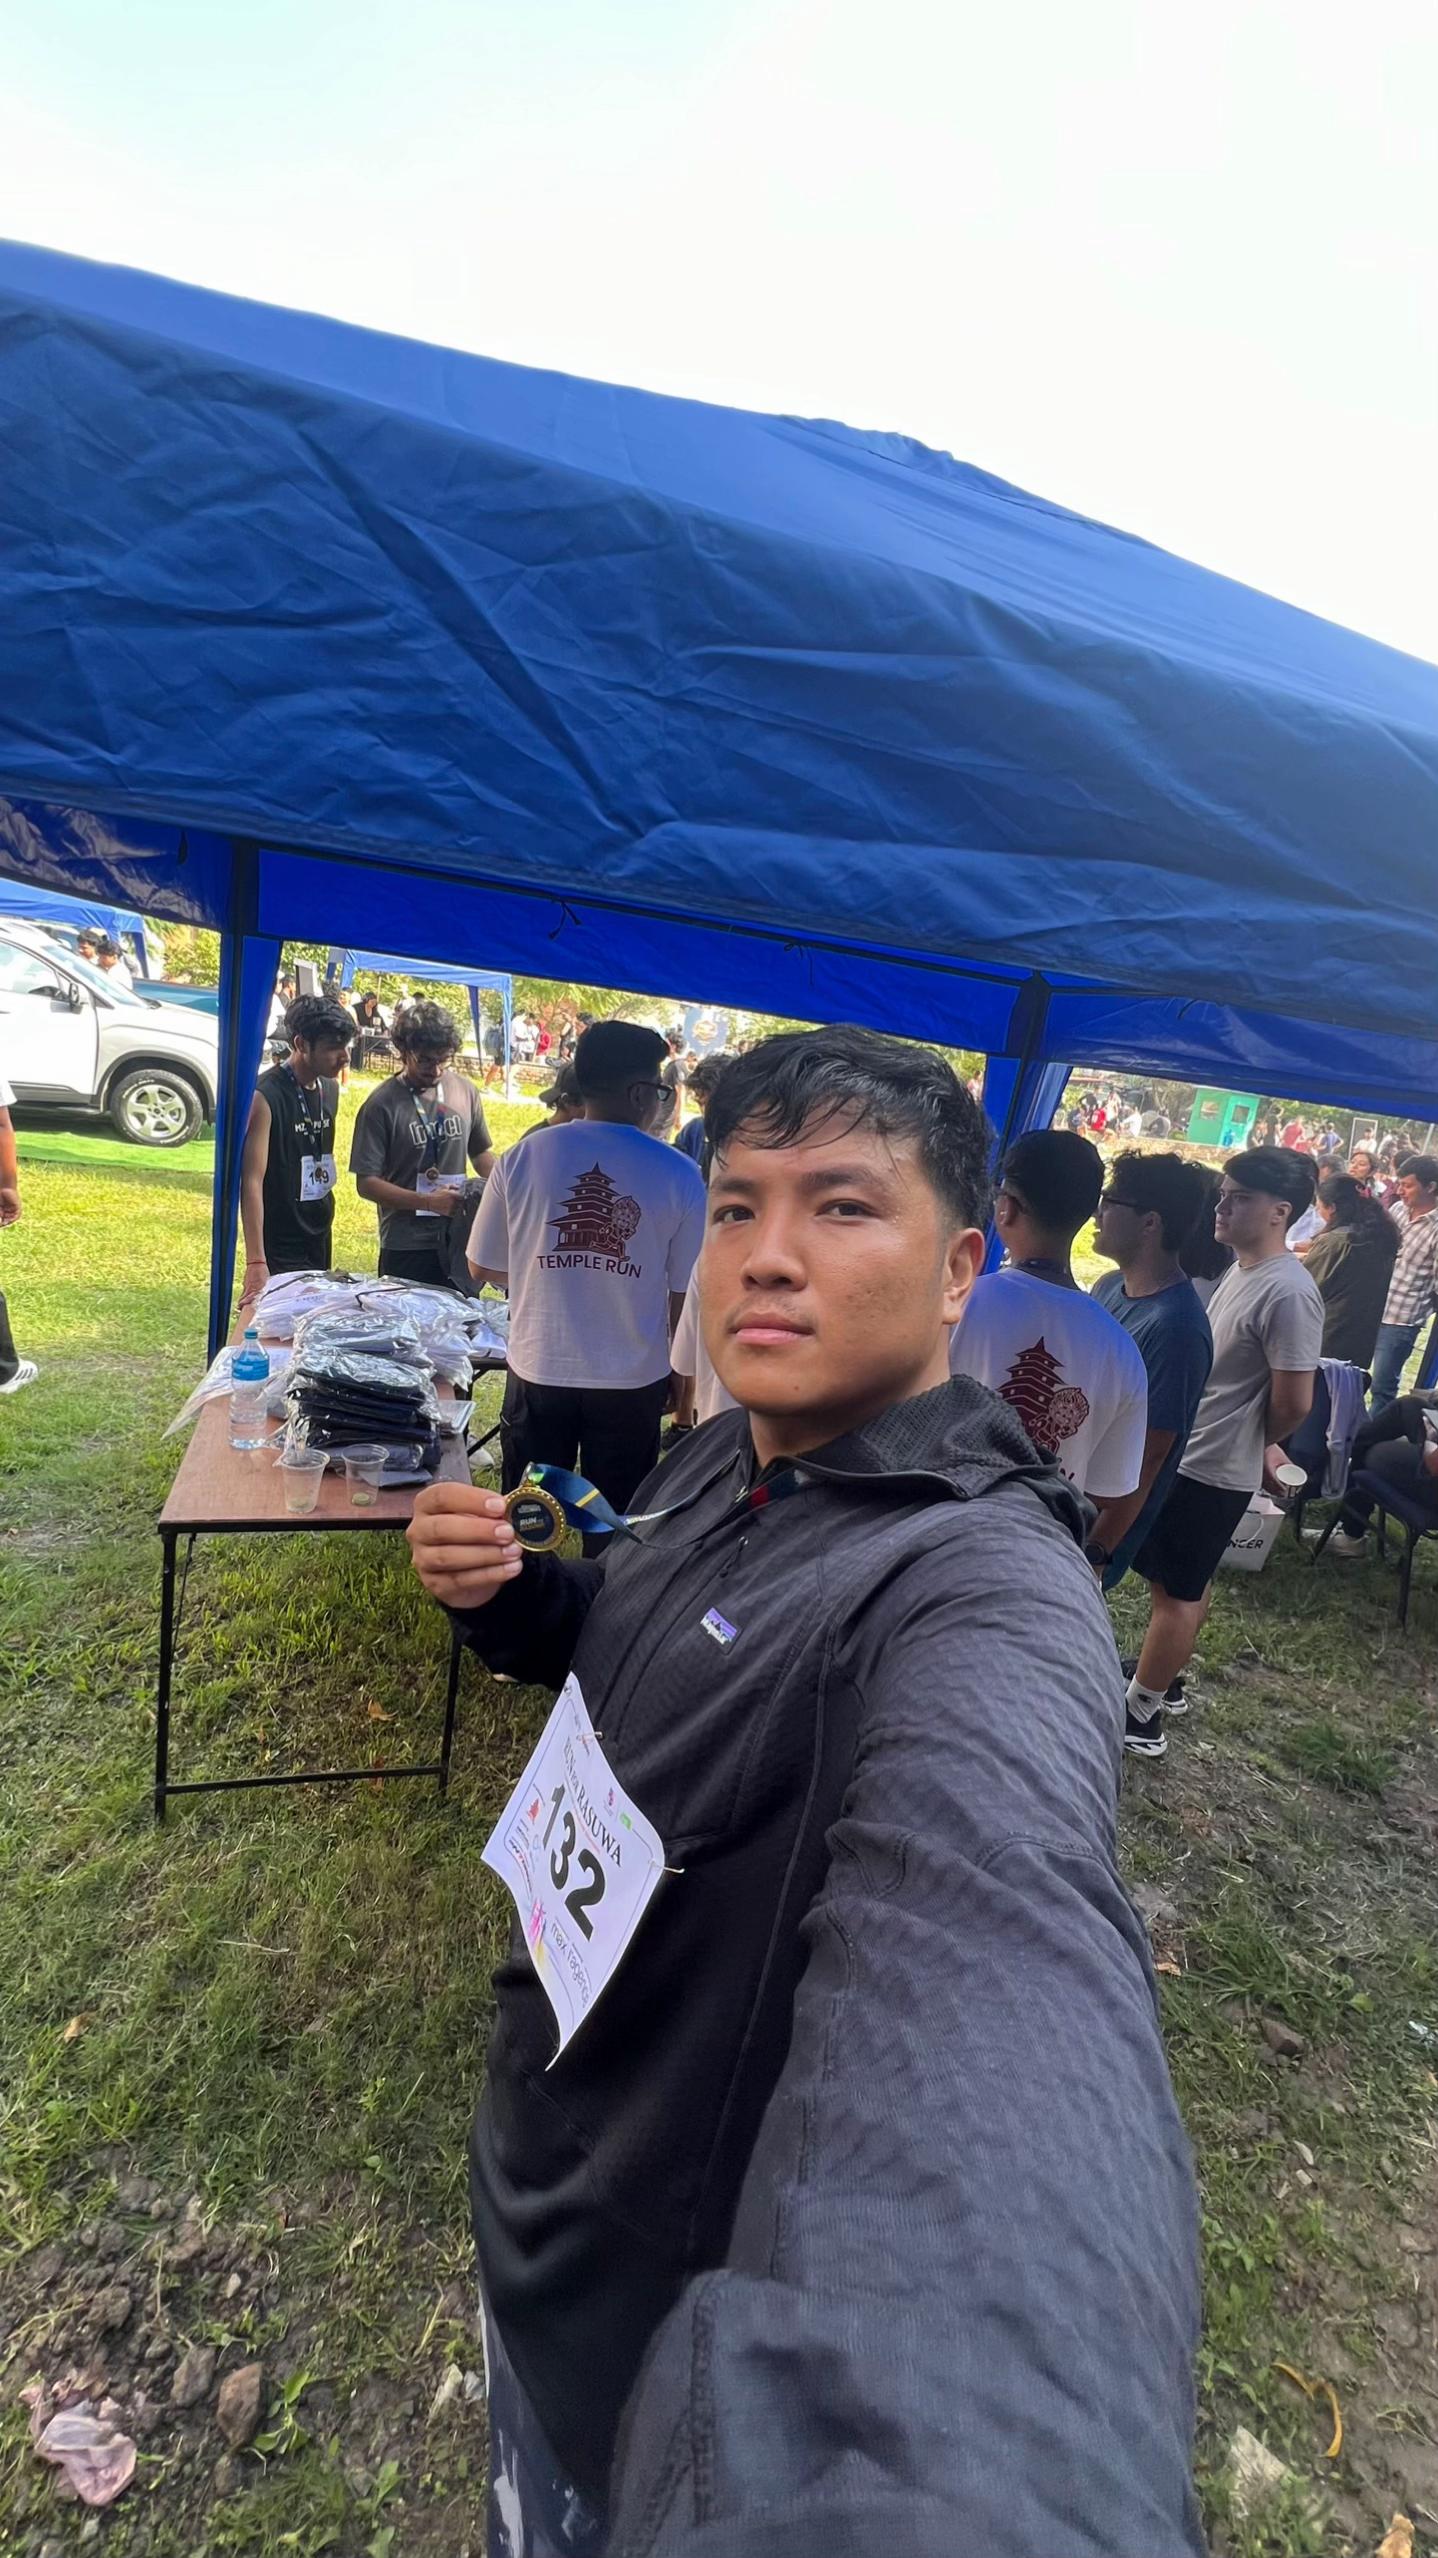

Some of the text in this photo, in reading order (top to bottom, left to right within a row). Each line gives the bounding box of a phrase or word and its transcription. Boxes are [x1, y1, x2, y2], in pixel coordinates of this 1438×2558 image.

[309, 1170, 330, 1186] 19
[536, 1254, 642, 1279] TEMPLE RUN
[577, 1783, 622, 1868] RASUWA
[542, 1783, 606, 1943] 132
